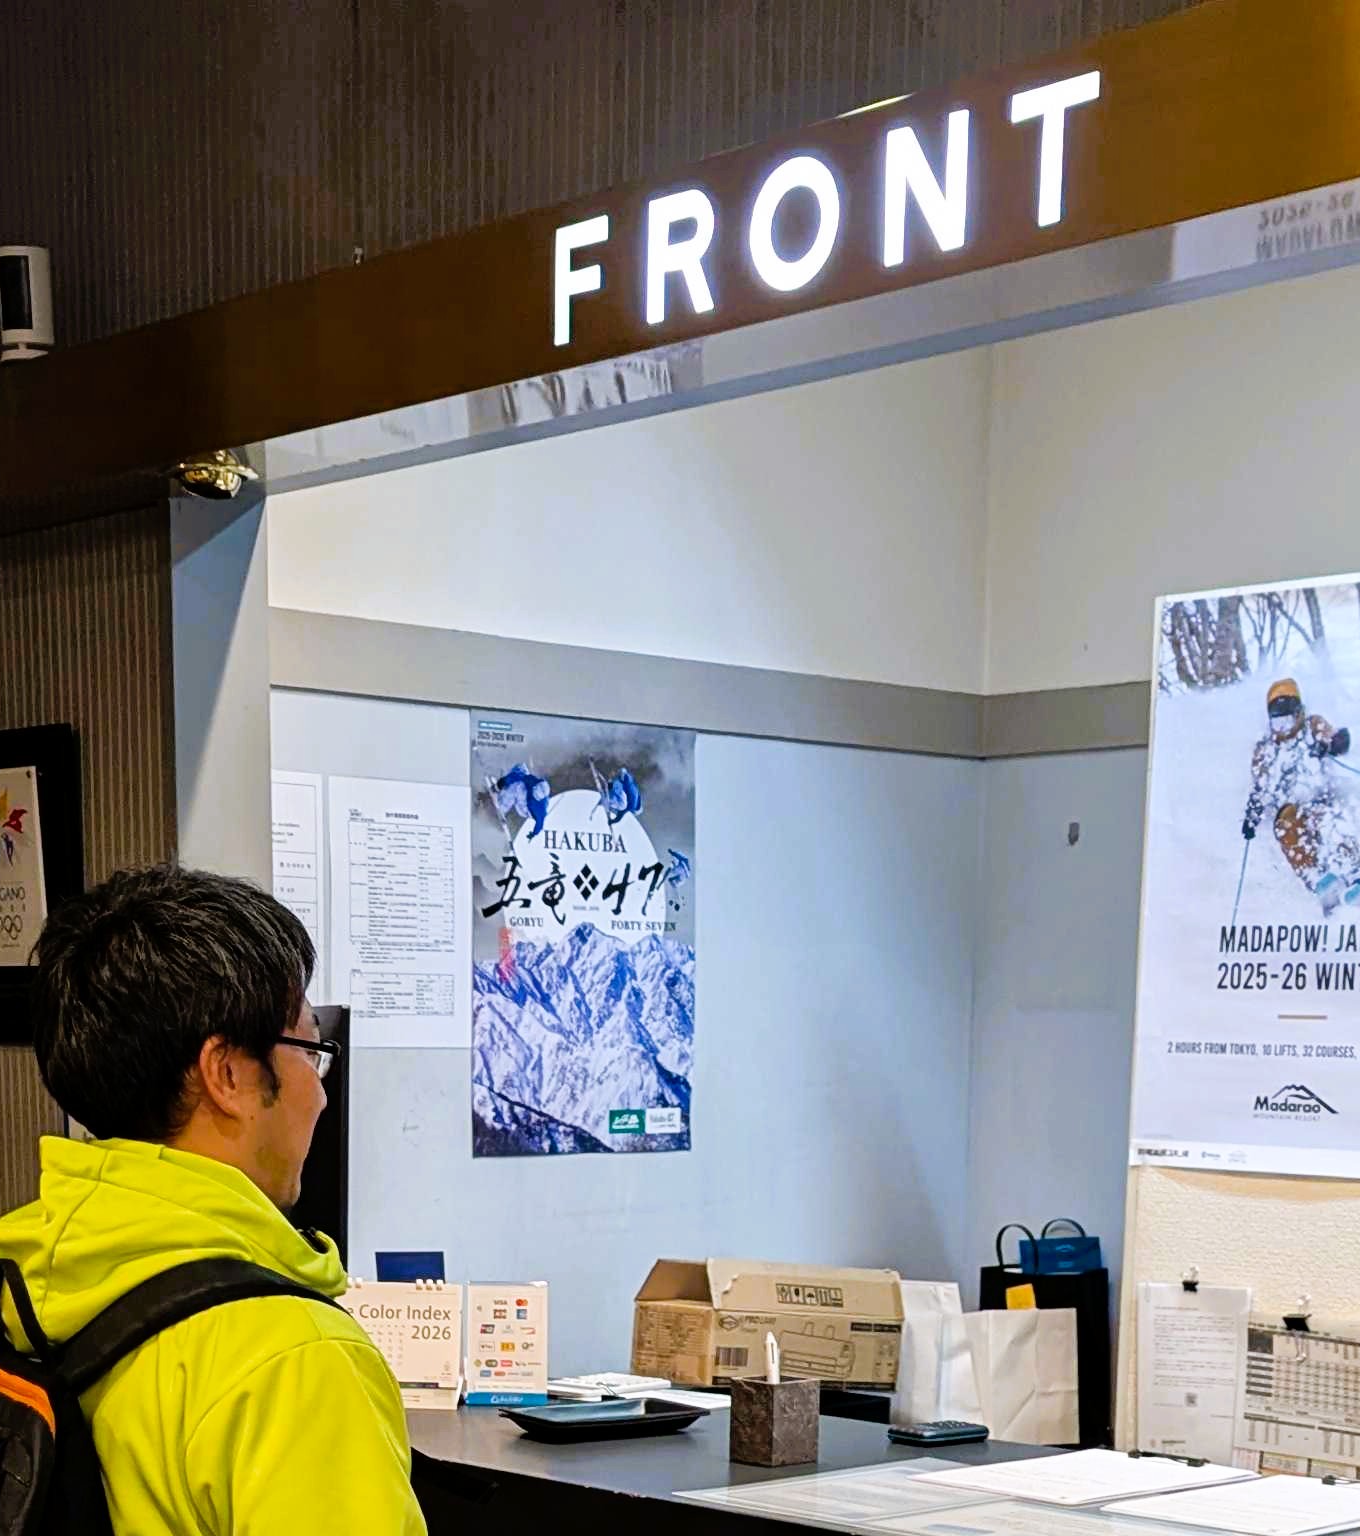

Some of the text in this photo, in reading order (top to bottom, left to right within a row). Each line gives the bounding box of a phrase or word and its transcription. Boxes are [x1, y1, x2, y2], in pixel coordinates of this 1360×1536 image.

[552, 69, 1102, 347] FRONT
[544, 830, 628, 853] HAKUBA
[509, 916, 544, 928] GORYU
[611, 919, 677, 931] FORTY SEVEN
[1218, 925, 1329, 953] MADAPOW!
[1217, 962, 1307, 990] 2025-26
[1175, 1042, 1202, 1054] HOURS
[1204, 1042, 1227, 1055] FROM
[1230, 1043, 1258, 1056] TOKYO,
[1262, 1044, 1272, 1056] 10
[1274, 1045, 1299, 1058] LIFTS,
[1302, 1045, 1314, 1057] 32
[1315, 1045, 1357, 1059] COURSES,
[1253, 1095, 1321, 1114] Madarao
[359, 1304, 451, 1320] Color Index
[411, 1325, 452, 1340] 2026
